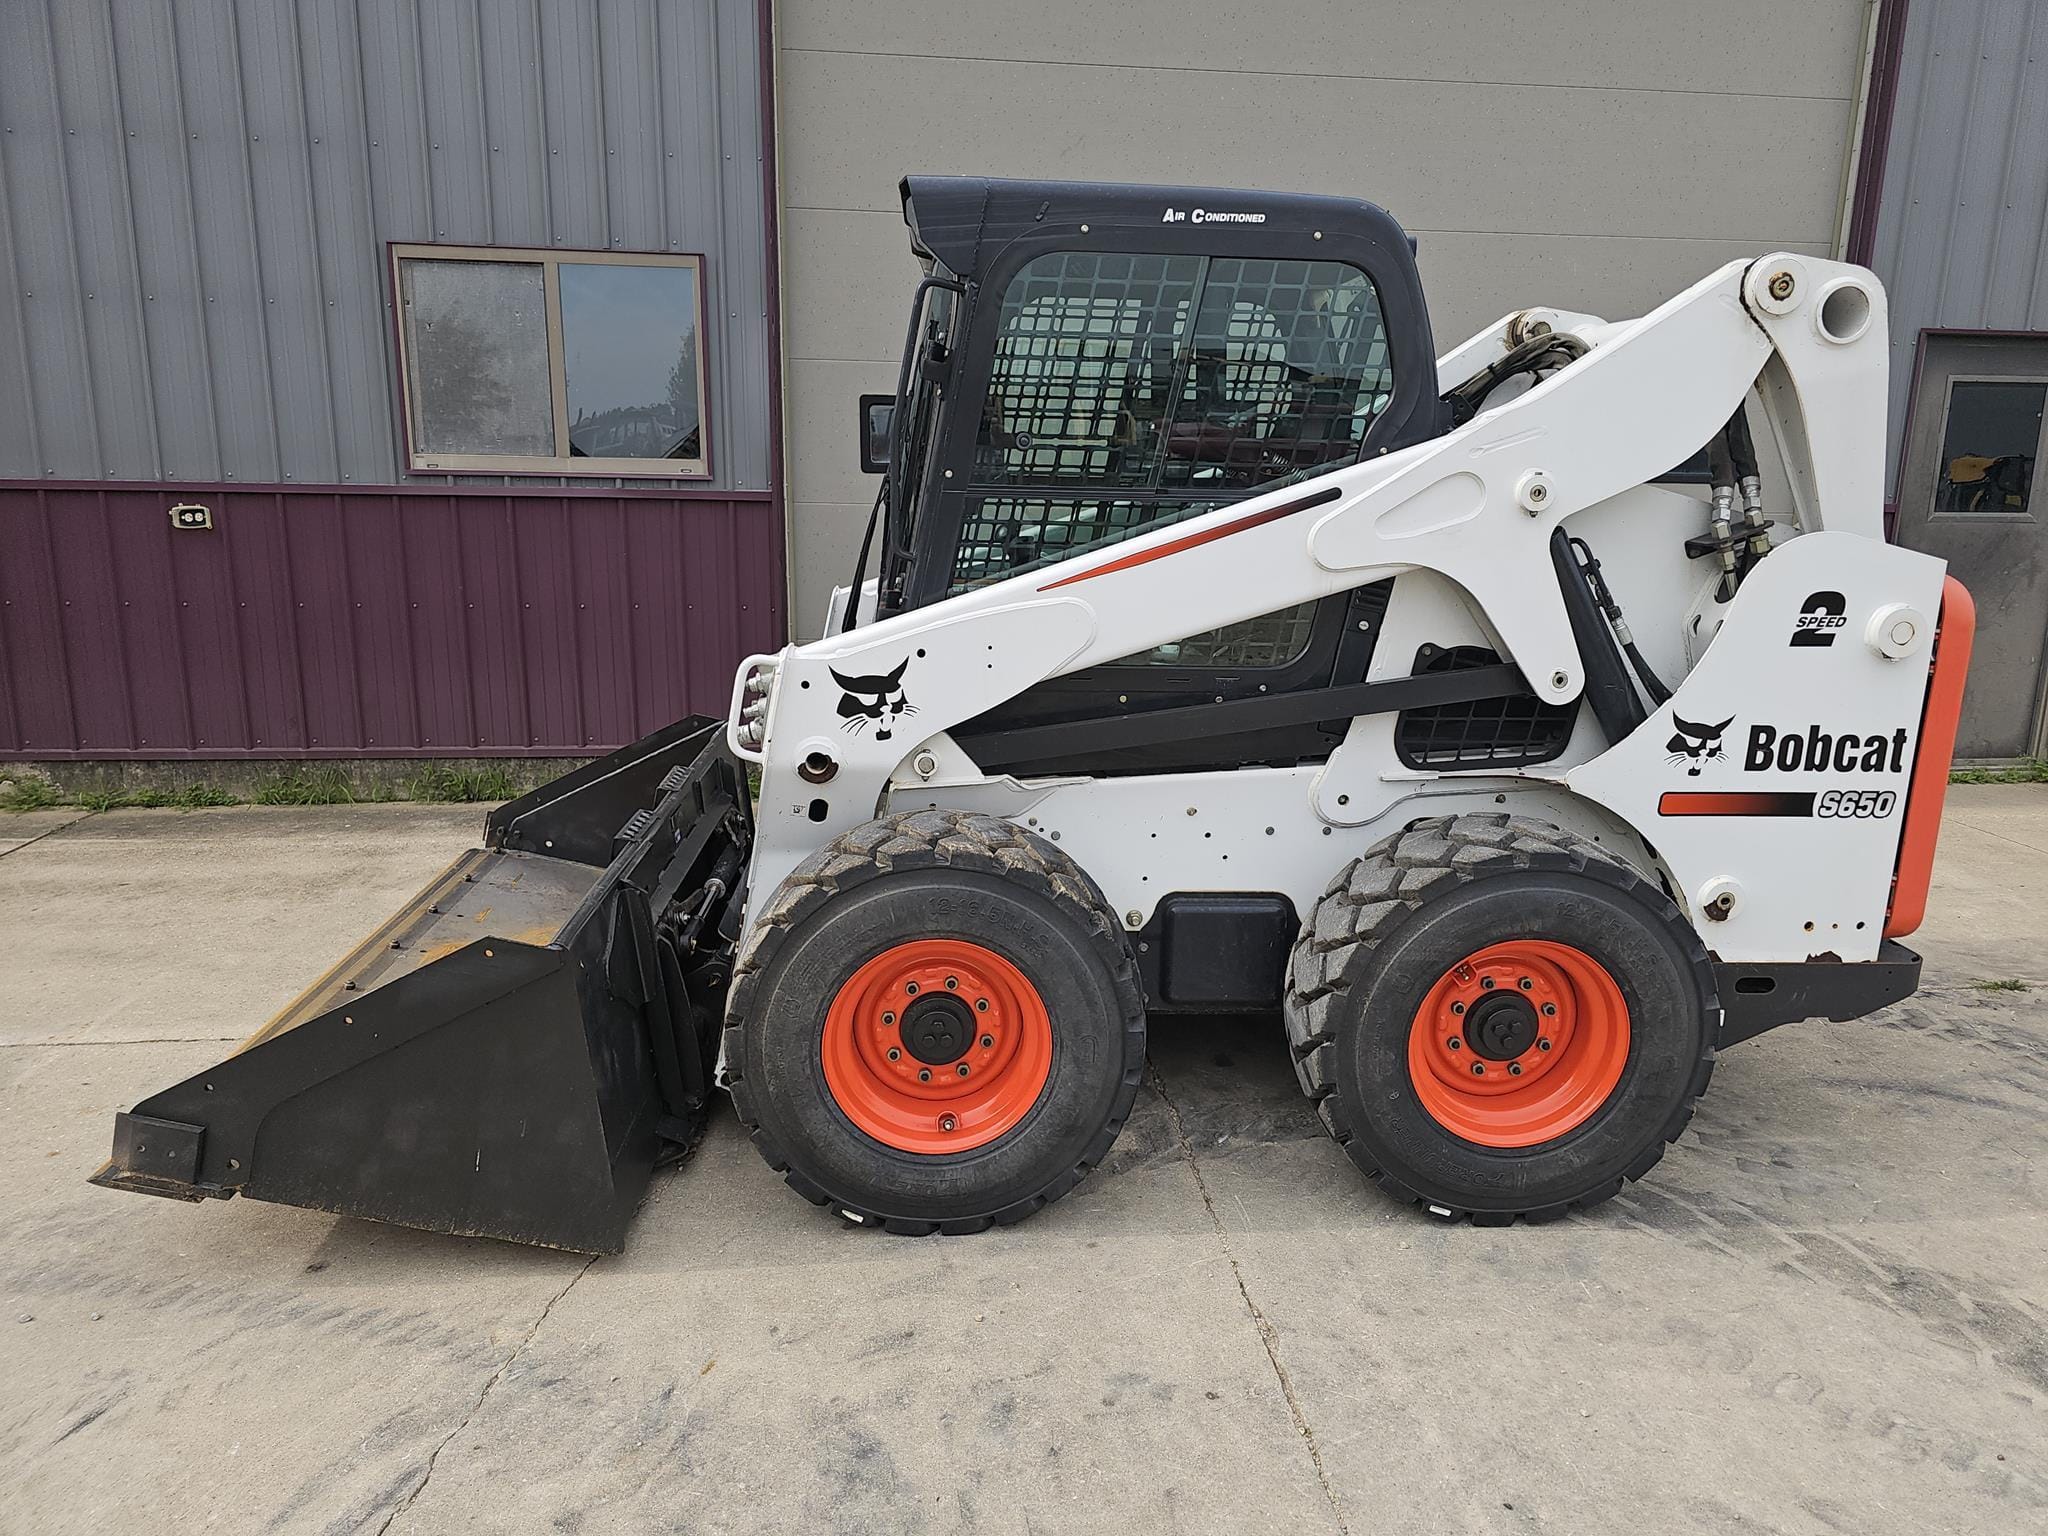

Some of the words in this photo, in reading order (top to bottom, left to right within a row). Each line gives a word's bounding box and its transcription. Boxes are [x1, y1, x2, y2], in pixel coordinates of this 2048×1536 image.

[1162, 207, 1186, 223] AIR
[1191, 208, 1266, 224] CONDITIONED
[1789, 591, 1847, 648] 2
[1796, 616, 1848, 628] SPEED
[1743, 723, 1908, 773] Bobcat
[1817, 790, 1897, 819] S650
